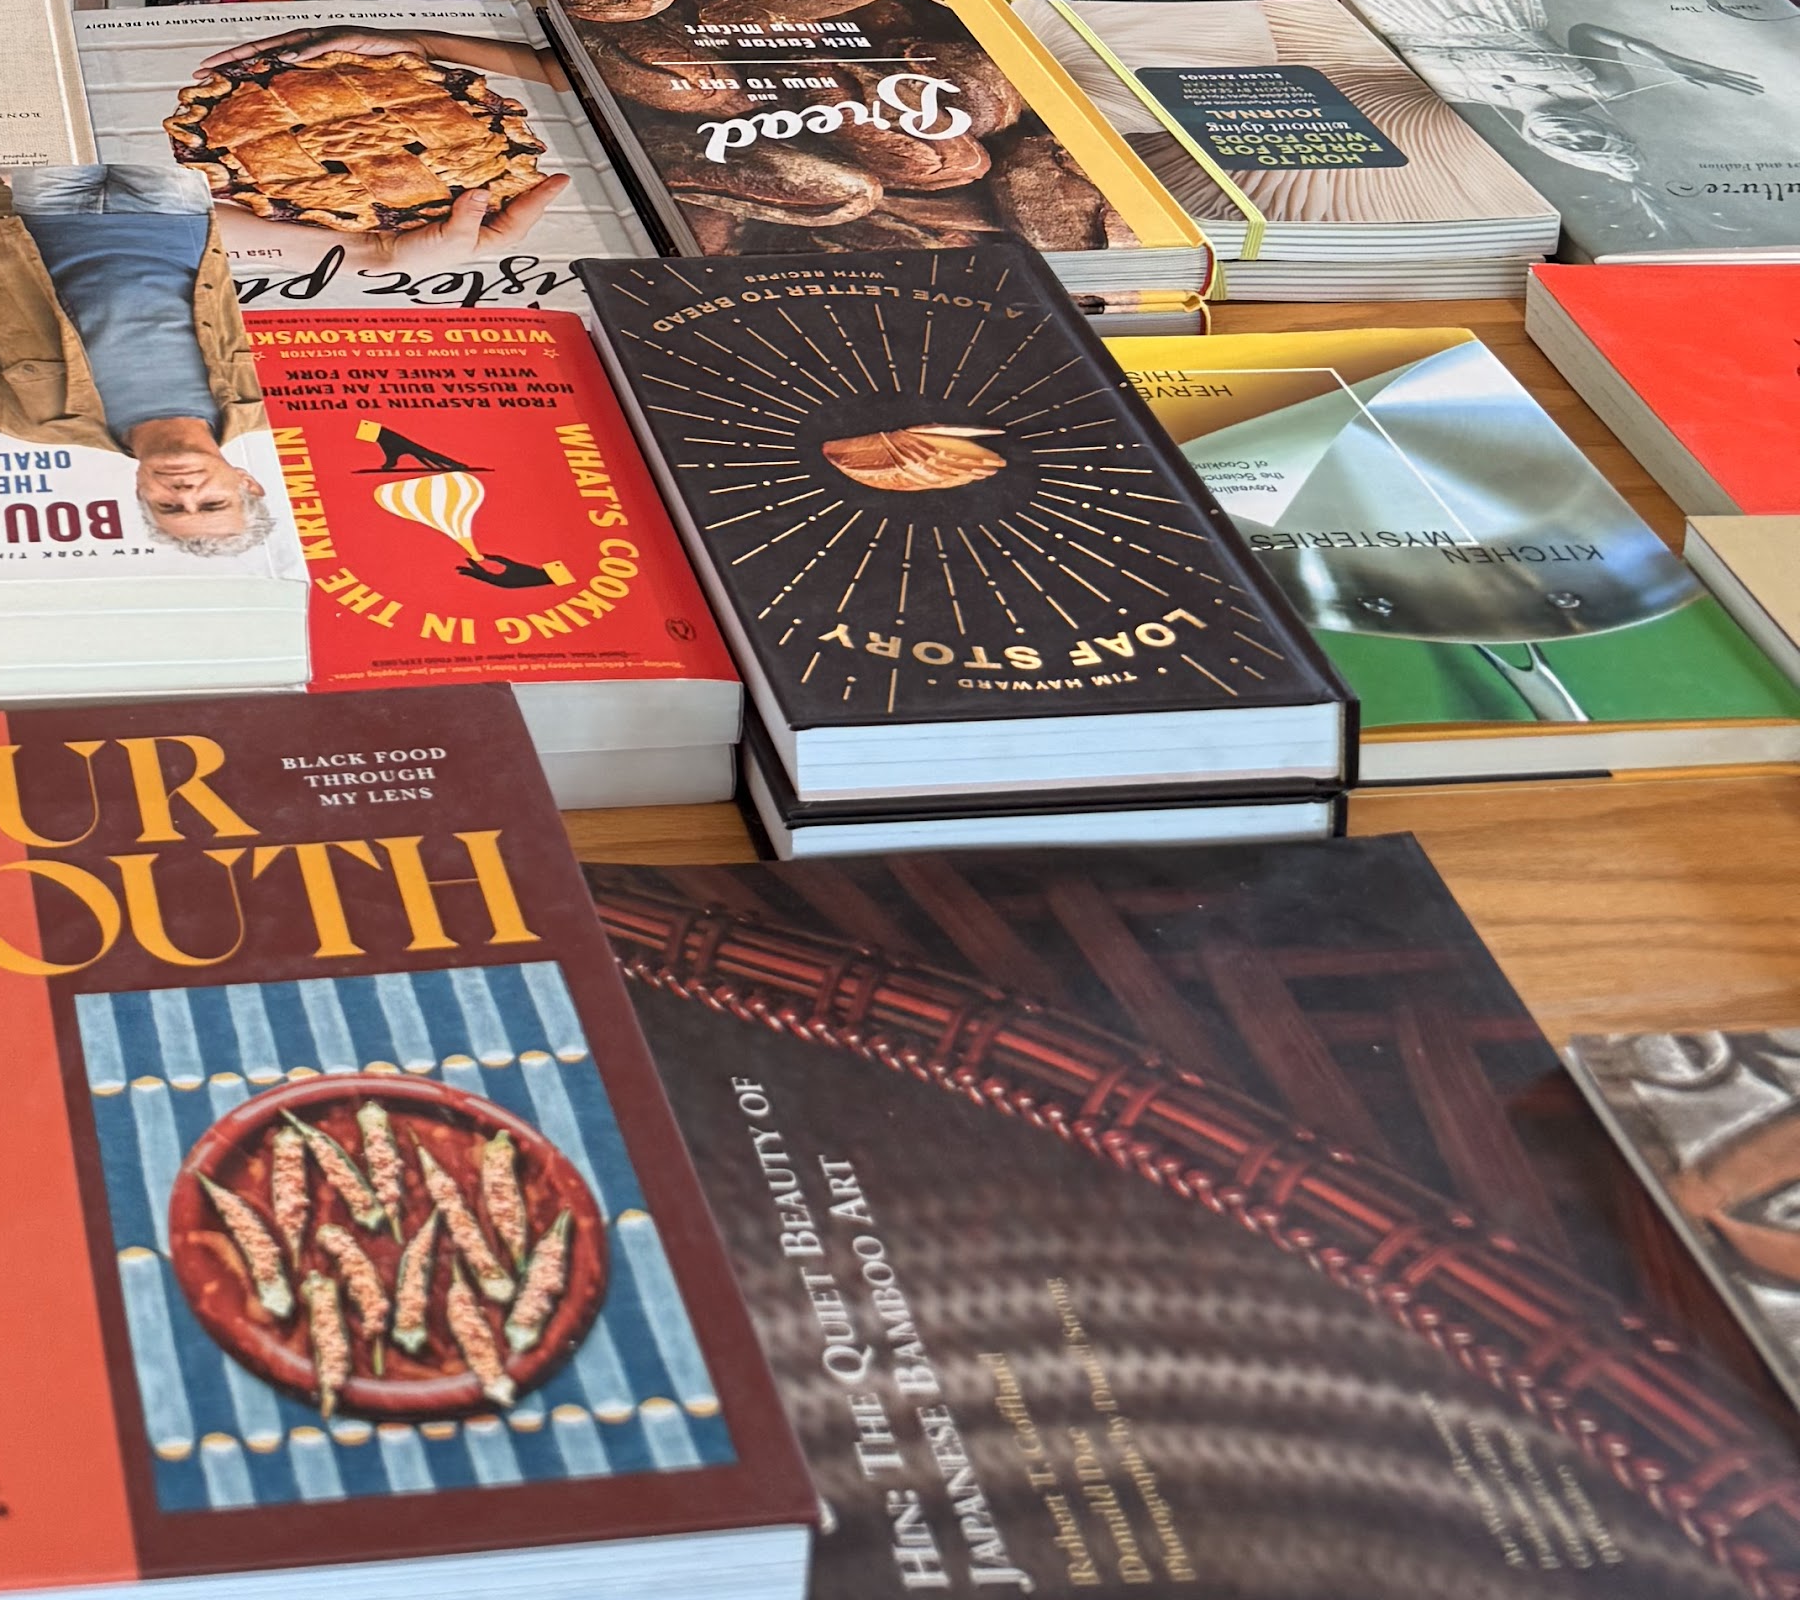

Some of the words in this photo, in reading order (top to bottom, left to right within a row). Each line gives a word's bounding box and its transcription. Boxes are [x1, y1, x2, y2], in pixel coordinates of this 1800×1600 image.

[696, 72, 973, 164] Bread
[1250, 530, 1456, 551] MYSTERIES
[1443, 545, 1605, 566] KITCHEN
[817, 622, 1043, 671] STORY
[1070, 607, 1209, 667] LOAF
